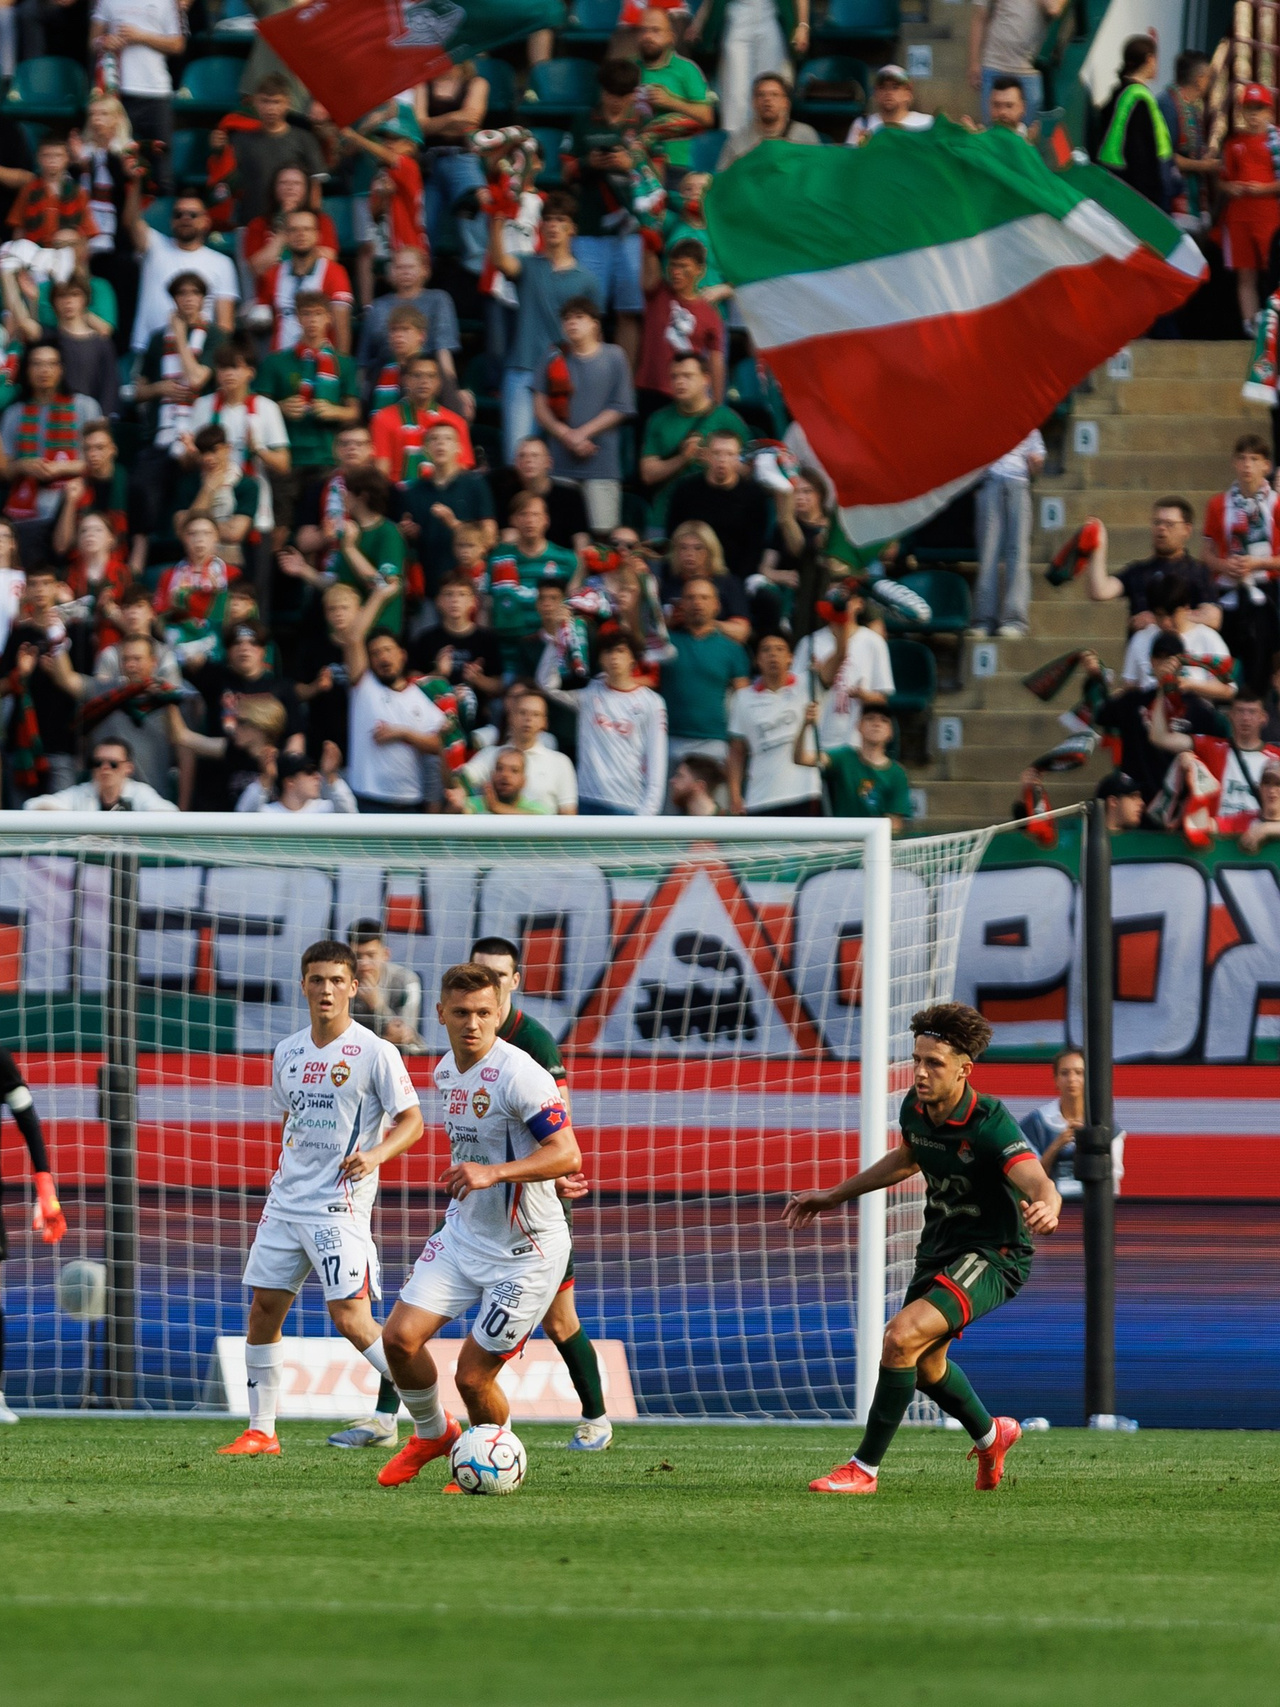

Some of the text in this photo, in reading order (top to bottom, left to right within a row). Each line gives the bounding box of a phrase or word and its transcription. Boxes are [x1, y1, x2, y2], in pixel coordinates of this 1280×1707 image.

[304, 1061, 329, 1072] FON
[302, 1073, 326, 1084] BET
[483, 1068, 498, 1080] wb
[451, 1089, 469, 1102] FON
[307, 1100, 334, 1110] ЗНАК
[449, 1103, 468, 1115] BET
[298, 1119, 337, 1130] Р-ФАРМ
[456, 1132, 479, 1144] ЗНАК
[910, 1132, 947, 1152] BetBoom
[322, 1255, 341, 1287] 17
[952, 1252, 990, 1289] 11
[481, 1301, 510, 1338] 10
